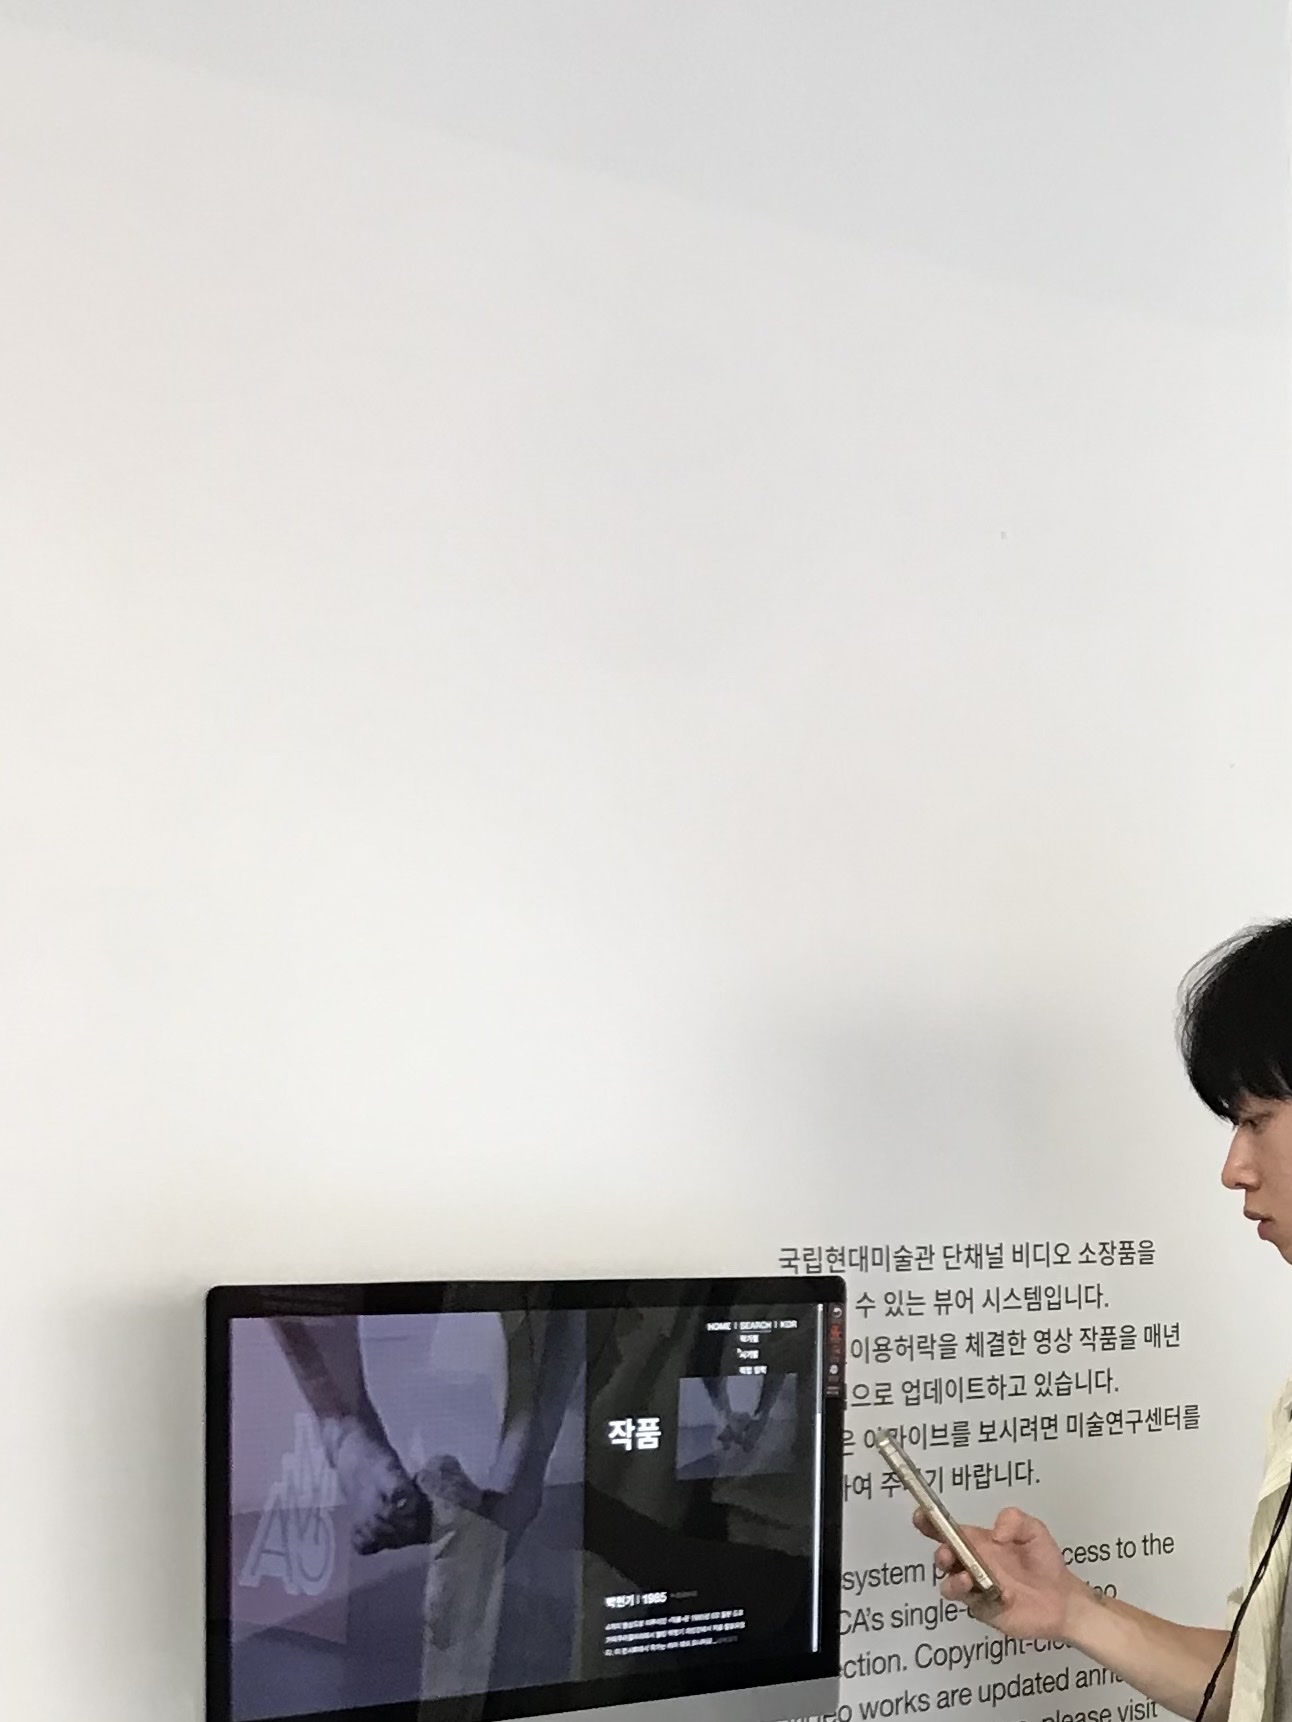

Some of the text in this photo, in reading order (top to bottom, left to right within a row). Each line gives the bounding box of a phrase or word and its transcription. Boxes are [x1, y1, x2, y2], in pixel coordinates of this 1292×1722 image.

[778, 1239, 1156, 1275] 국립현대미술관 단채널 비디오 소장품을
[855, 1283, 1110, 1319] 수 있는 뷰어 시스템입니다.
[850, 1321, 1181, 1365] 이용허락을 체결한 영상 작품을 매년
[843, 1367, 1119, 1412] 으로 업데이트하고 있습니다.
[607, 1416, 662, 1451] 작품
[978, 1415, 1059, 1444] 보시려면
[1066, 1404, 1200, 1438] 미술연구센터를
[951, 1458, 1040, 1491] 바랍니다.
[842, 1562, 926, 1597] system
[1061, 1542, 1111, 1567] cess
[1116, 1537, 1138, 1559] to
[1142, 1533, 1175, 1556] the
[859, 1690, 931, 1721] works
[936, 1687, 972, 1710] are
[978, 1667, 1070, 1708] updated
